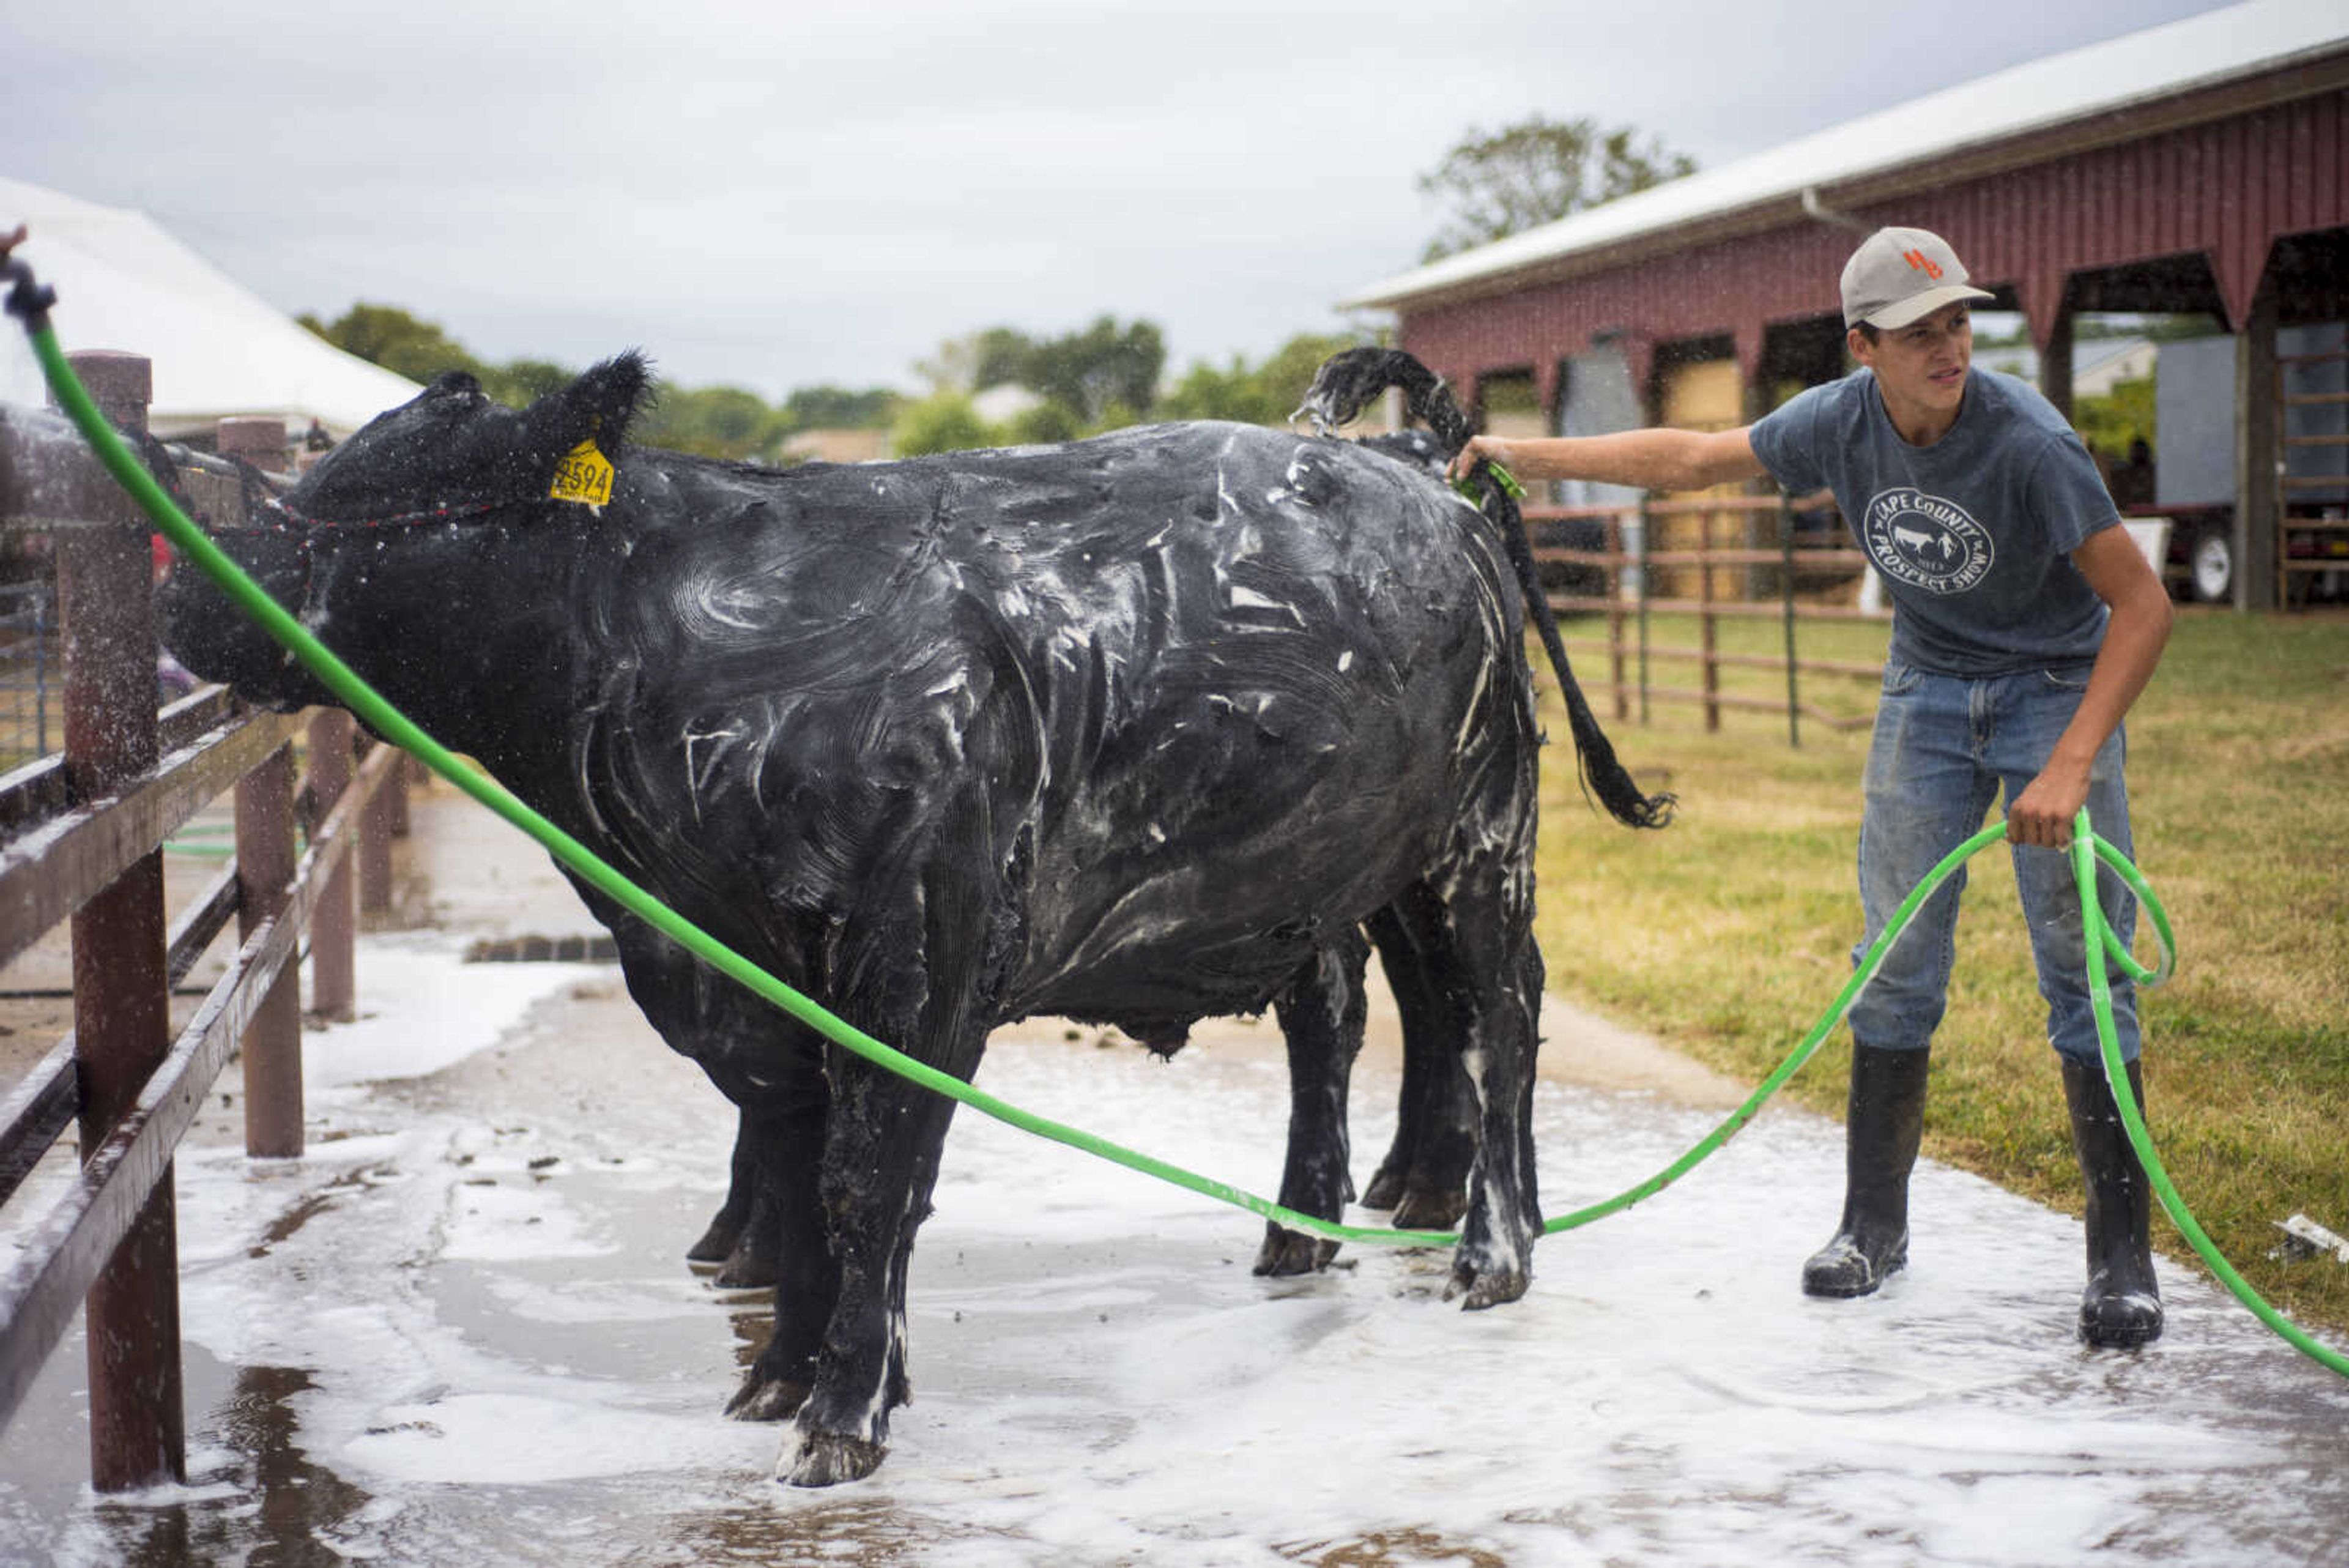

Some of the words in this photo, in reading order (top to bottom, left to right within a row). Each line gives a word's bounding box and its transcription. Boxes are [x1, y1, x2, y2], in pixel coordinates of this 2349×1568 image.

[1874, 494, 1910, 520] CAPE
[1913, 496, 1981, 538] COUNTY
[1871, 534, 1947, 590] PROSPECT
[1953, 553, 1988, 589] SHOW
